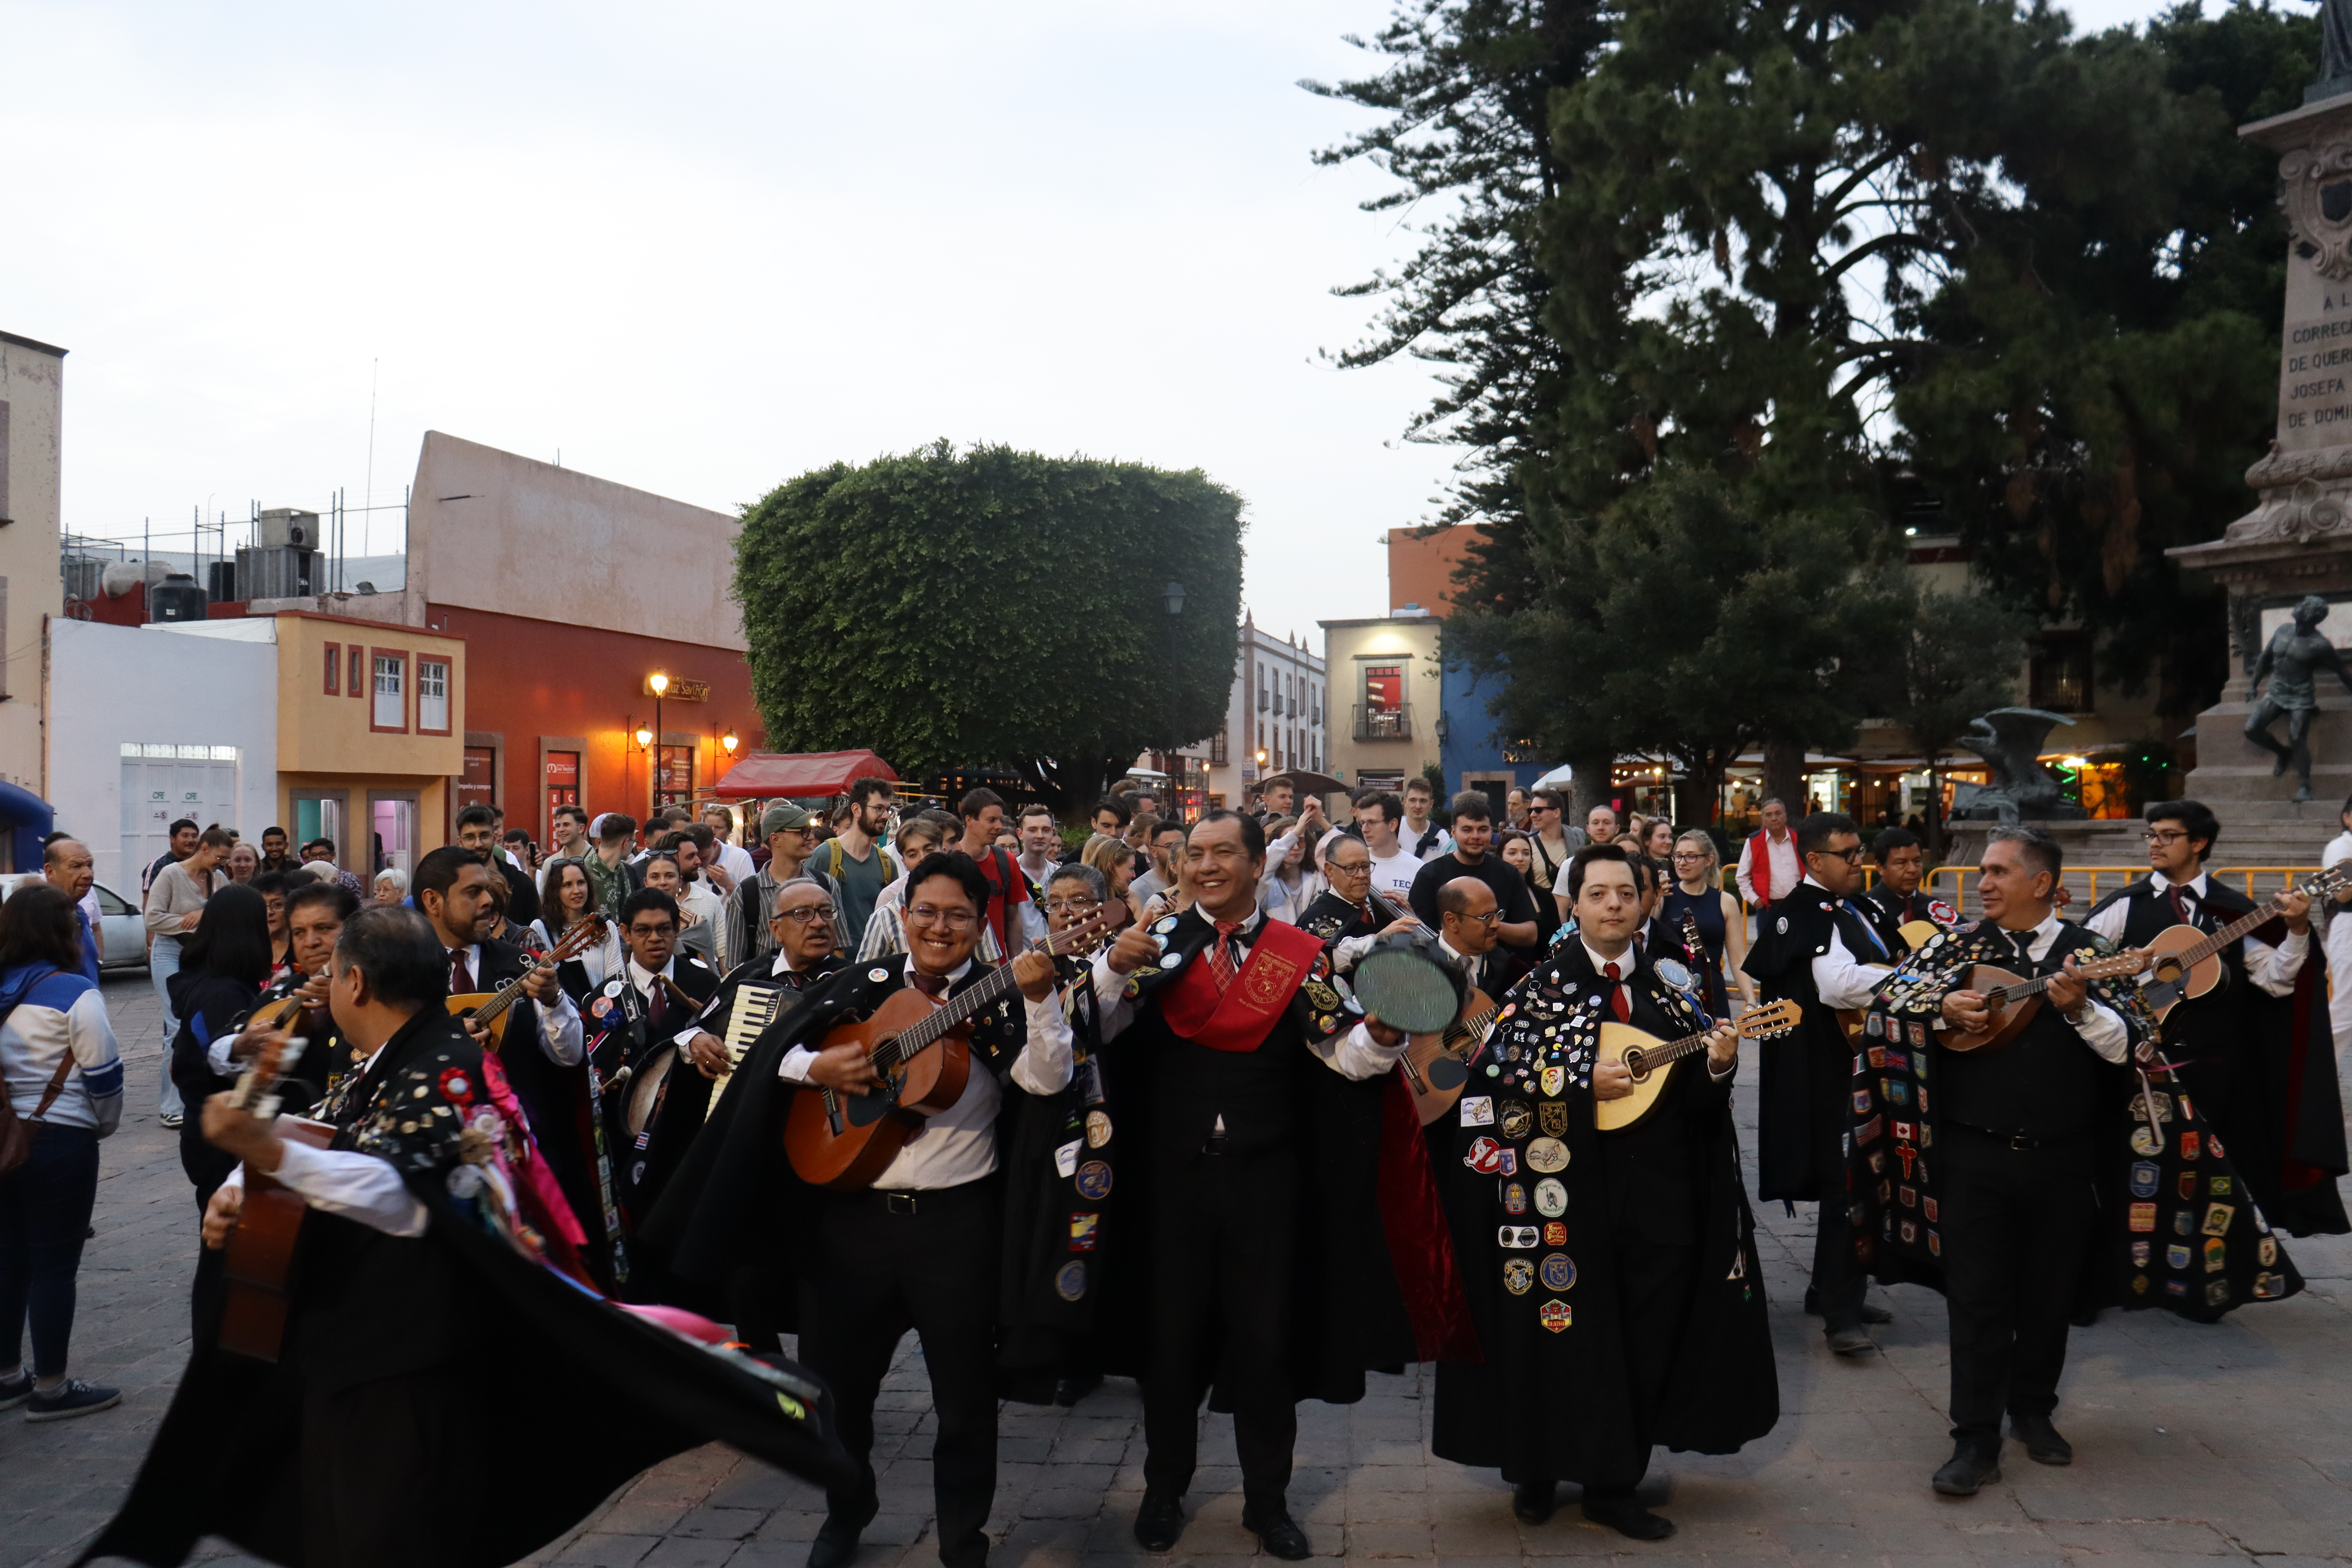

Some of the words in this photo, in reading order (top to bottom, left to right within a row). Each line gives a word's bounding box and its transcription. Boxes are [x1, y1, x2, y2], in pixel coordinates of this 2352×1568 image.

[2324, 296, 2333, 310] A
[2290, 357, 2307, 372] DE
[2313, 348, 2352, 368] QUER
[2290, 377, 2345, 399] JOSEFA
[2288, 412, 2307, 428] DE
[1393, 880, 1411, 889] TEC
